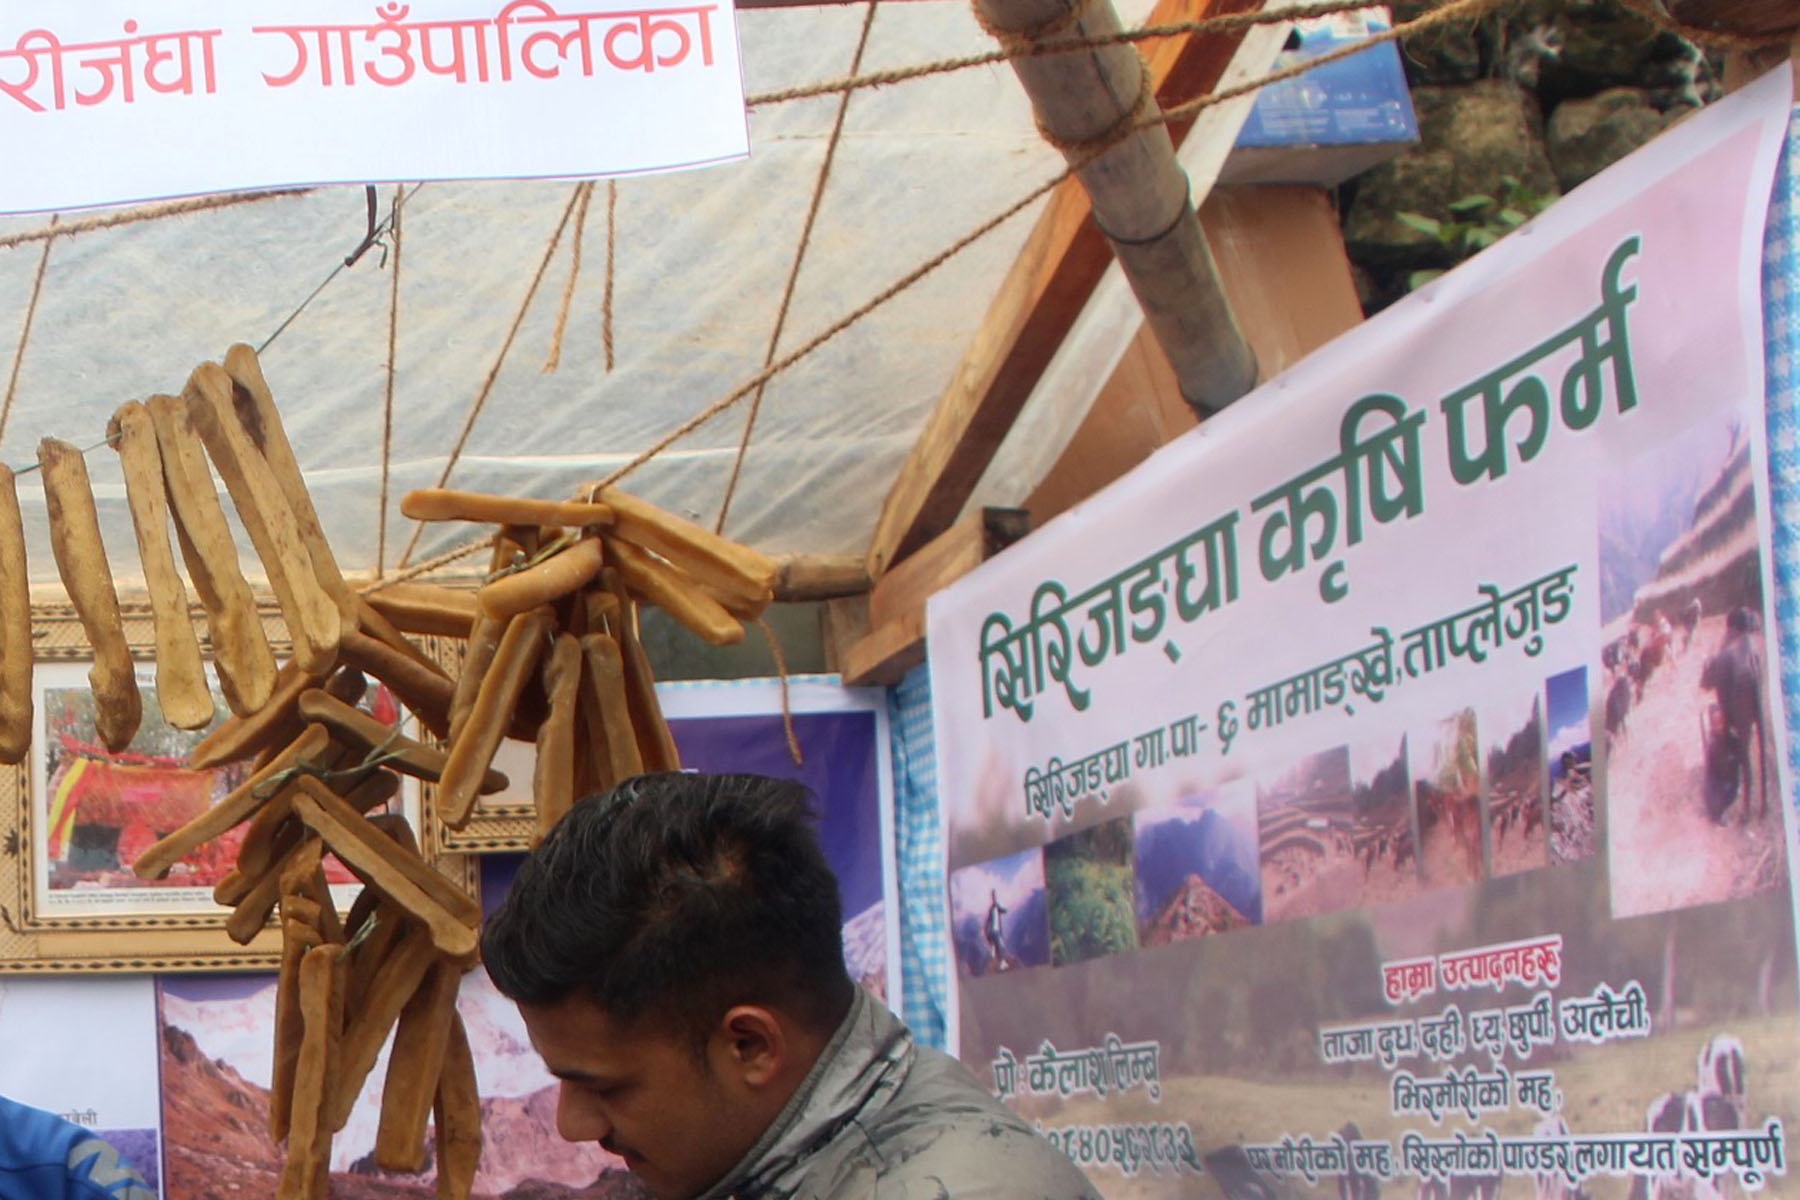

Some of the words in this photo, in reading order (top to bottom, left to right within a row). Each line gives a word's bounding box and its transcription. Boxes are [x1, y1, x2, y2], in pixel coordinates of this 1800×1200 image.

[252, 0, 718, 87] गाउँपालिका
[1251, 392, 1426, 603] कृषि
[1440, 234, 1643, 486] फर्म
